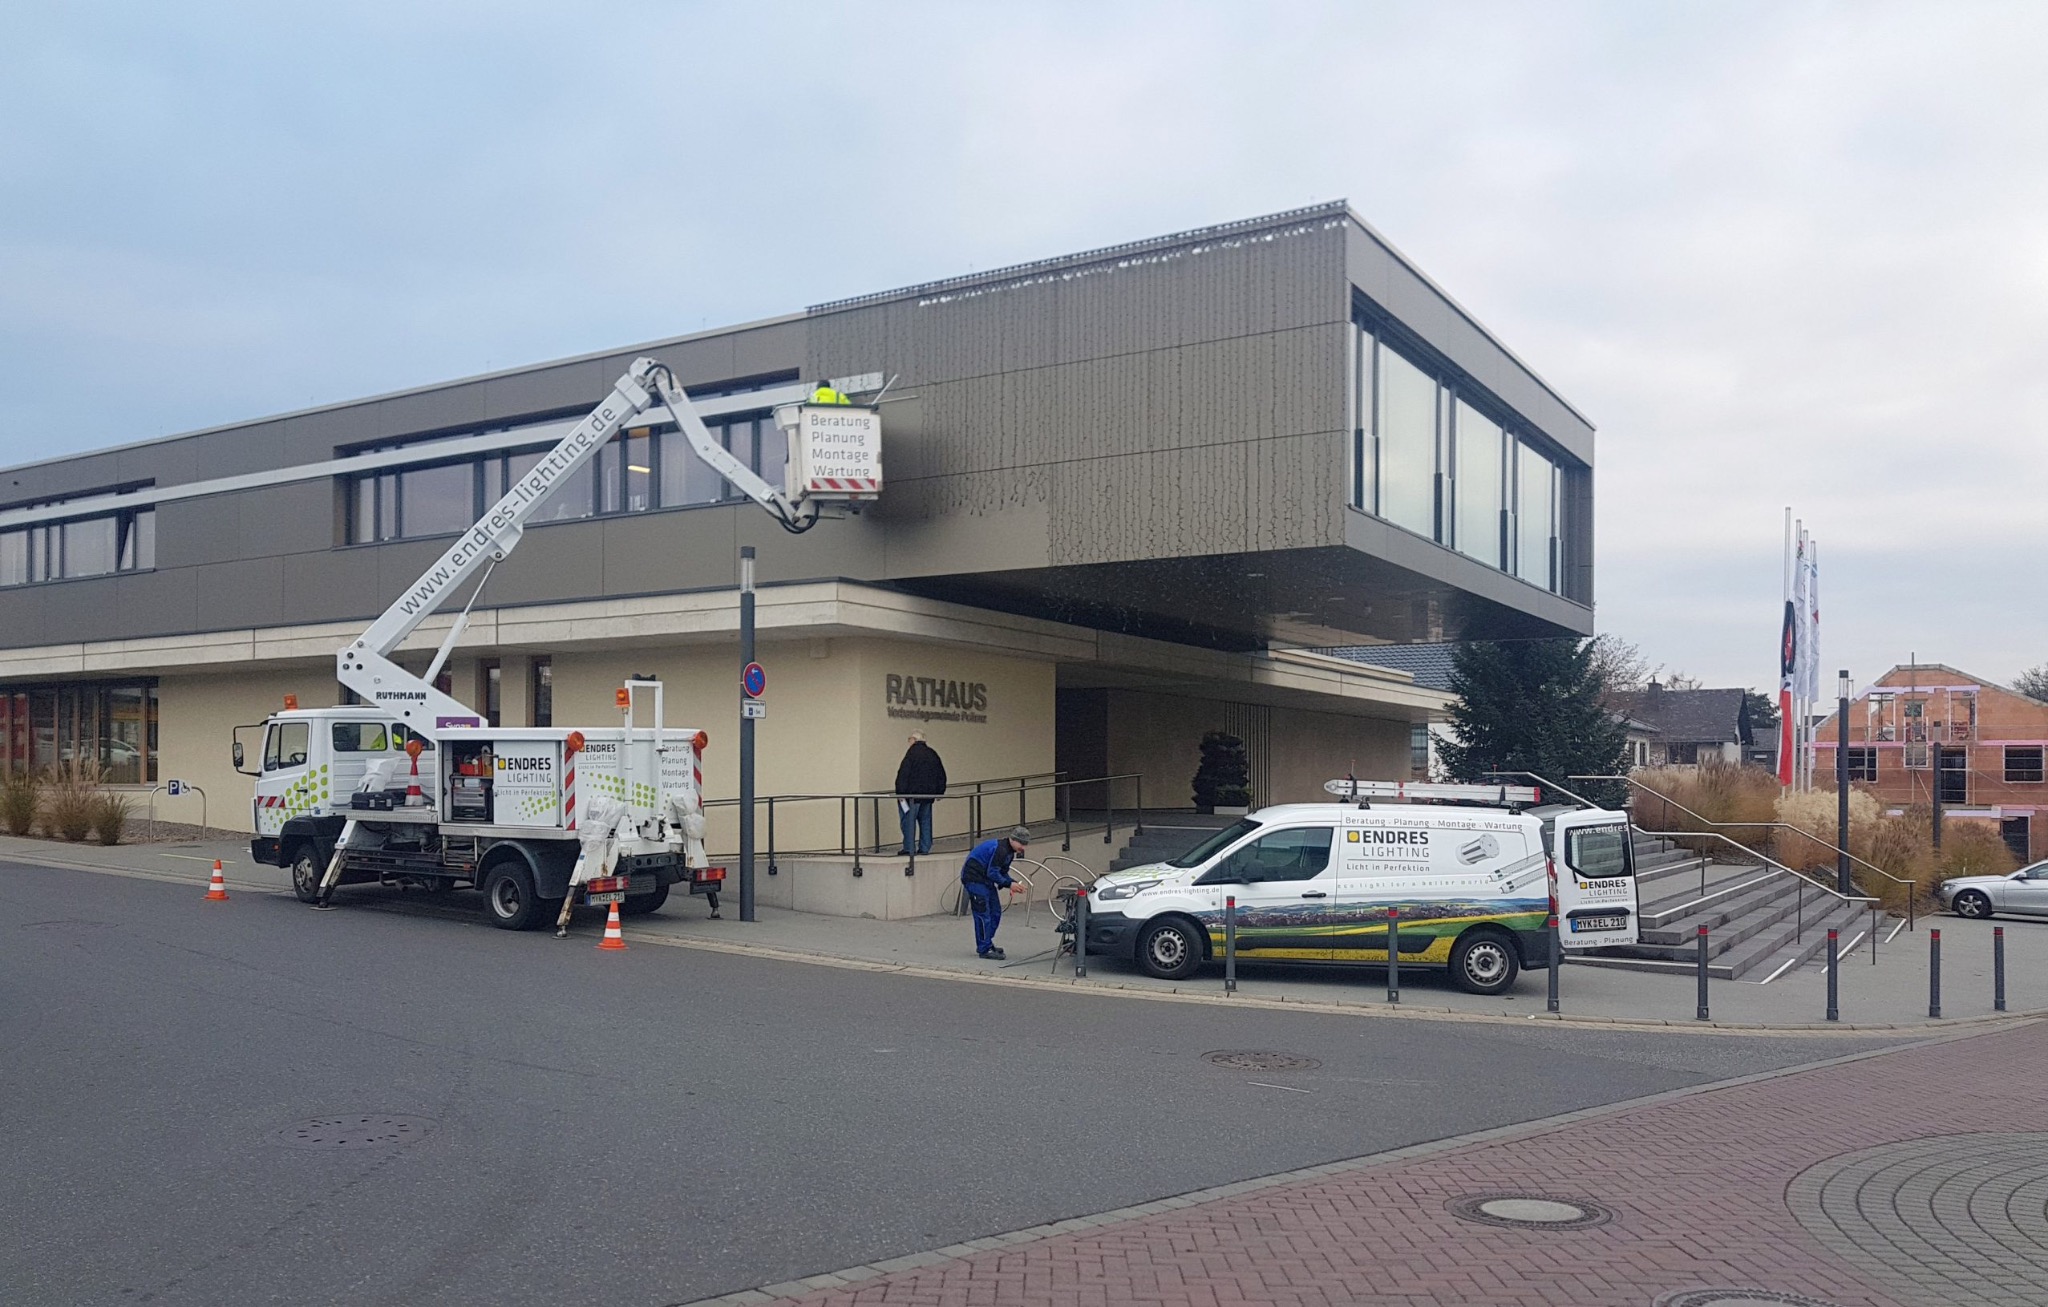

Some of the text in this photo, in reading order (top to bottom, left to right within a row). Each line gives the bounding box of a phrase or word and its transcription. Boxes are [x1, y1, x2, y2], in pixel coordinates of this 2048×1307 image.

[811, 414, 870, 430] Beratung
[812, 431, 864, 447] Planung
[812, 448, 869, 463] Montage
[813, 465, 870, 479] Wartung
[400, 406, 616, 616] www.endres-lighting.de
[376, 691, 427, 700] RUTHMANN
[886, 673, 987, 712] RATHAUS
[586, 743, 616, 753] ENDRES
[585, 753, 617, 761] LIGHTING
[661, 756, 688, 765] Planung
[508, 757, 552, 771] ENDRES
[507, 772, 552, 783] LIGHTING
[661, 768, 689, 777] Montage
[170, 781, 179, 794] P
[662, 781, 689, 790] Wartung
[521, 788, 552, 796] Perfektion
[1345, 816, 1523, 831] Beratung Planung Montage Wartung
[1363, 830, 1429, 845] ENDRES
[1362, 846, 1430, 858] LIGHTING
[1346, 863, 1430, 872] Licht in Perfektion
[1588, 879, 1627, 889] ENDRES
[1588, 887, 1628, 897] LIGHTING
[1604, 936, 1634, 944] Planung
